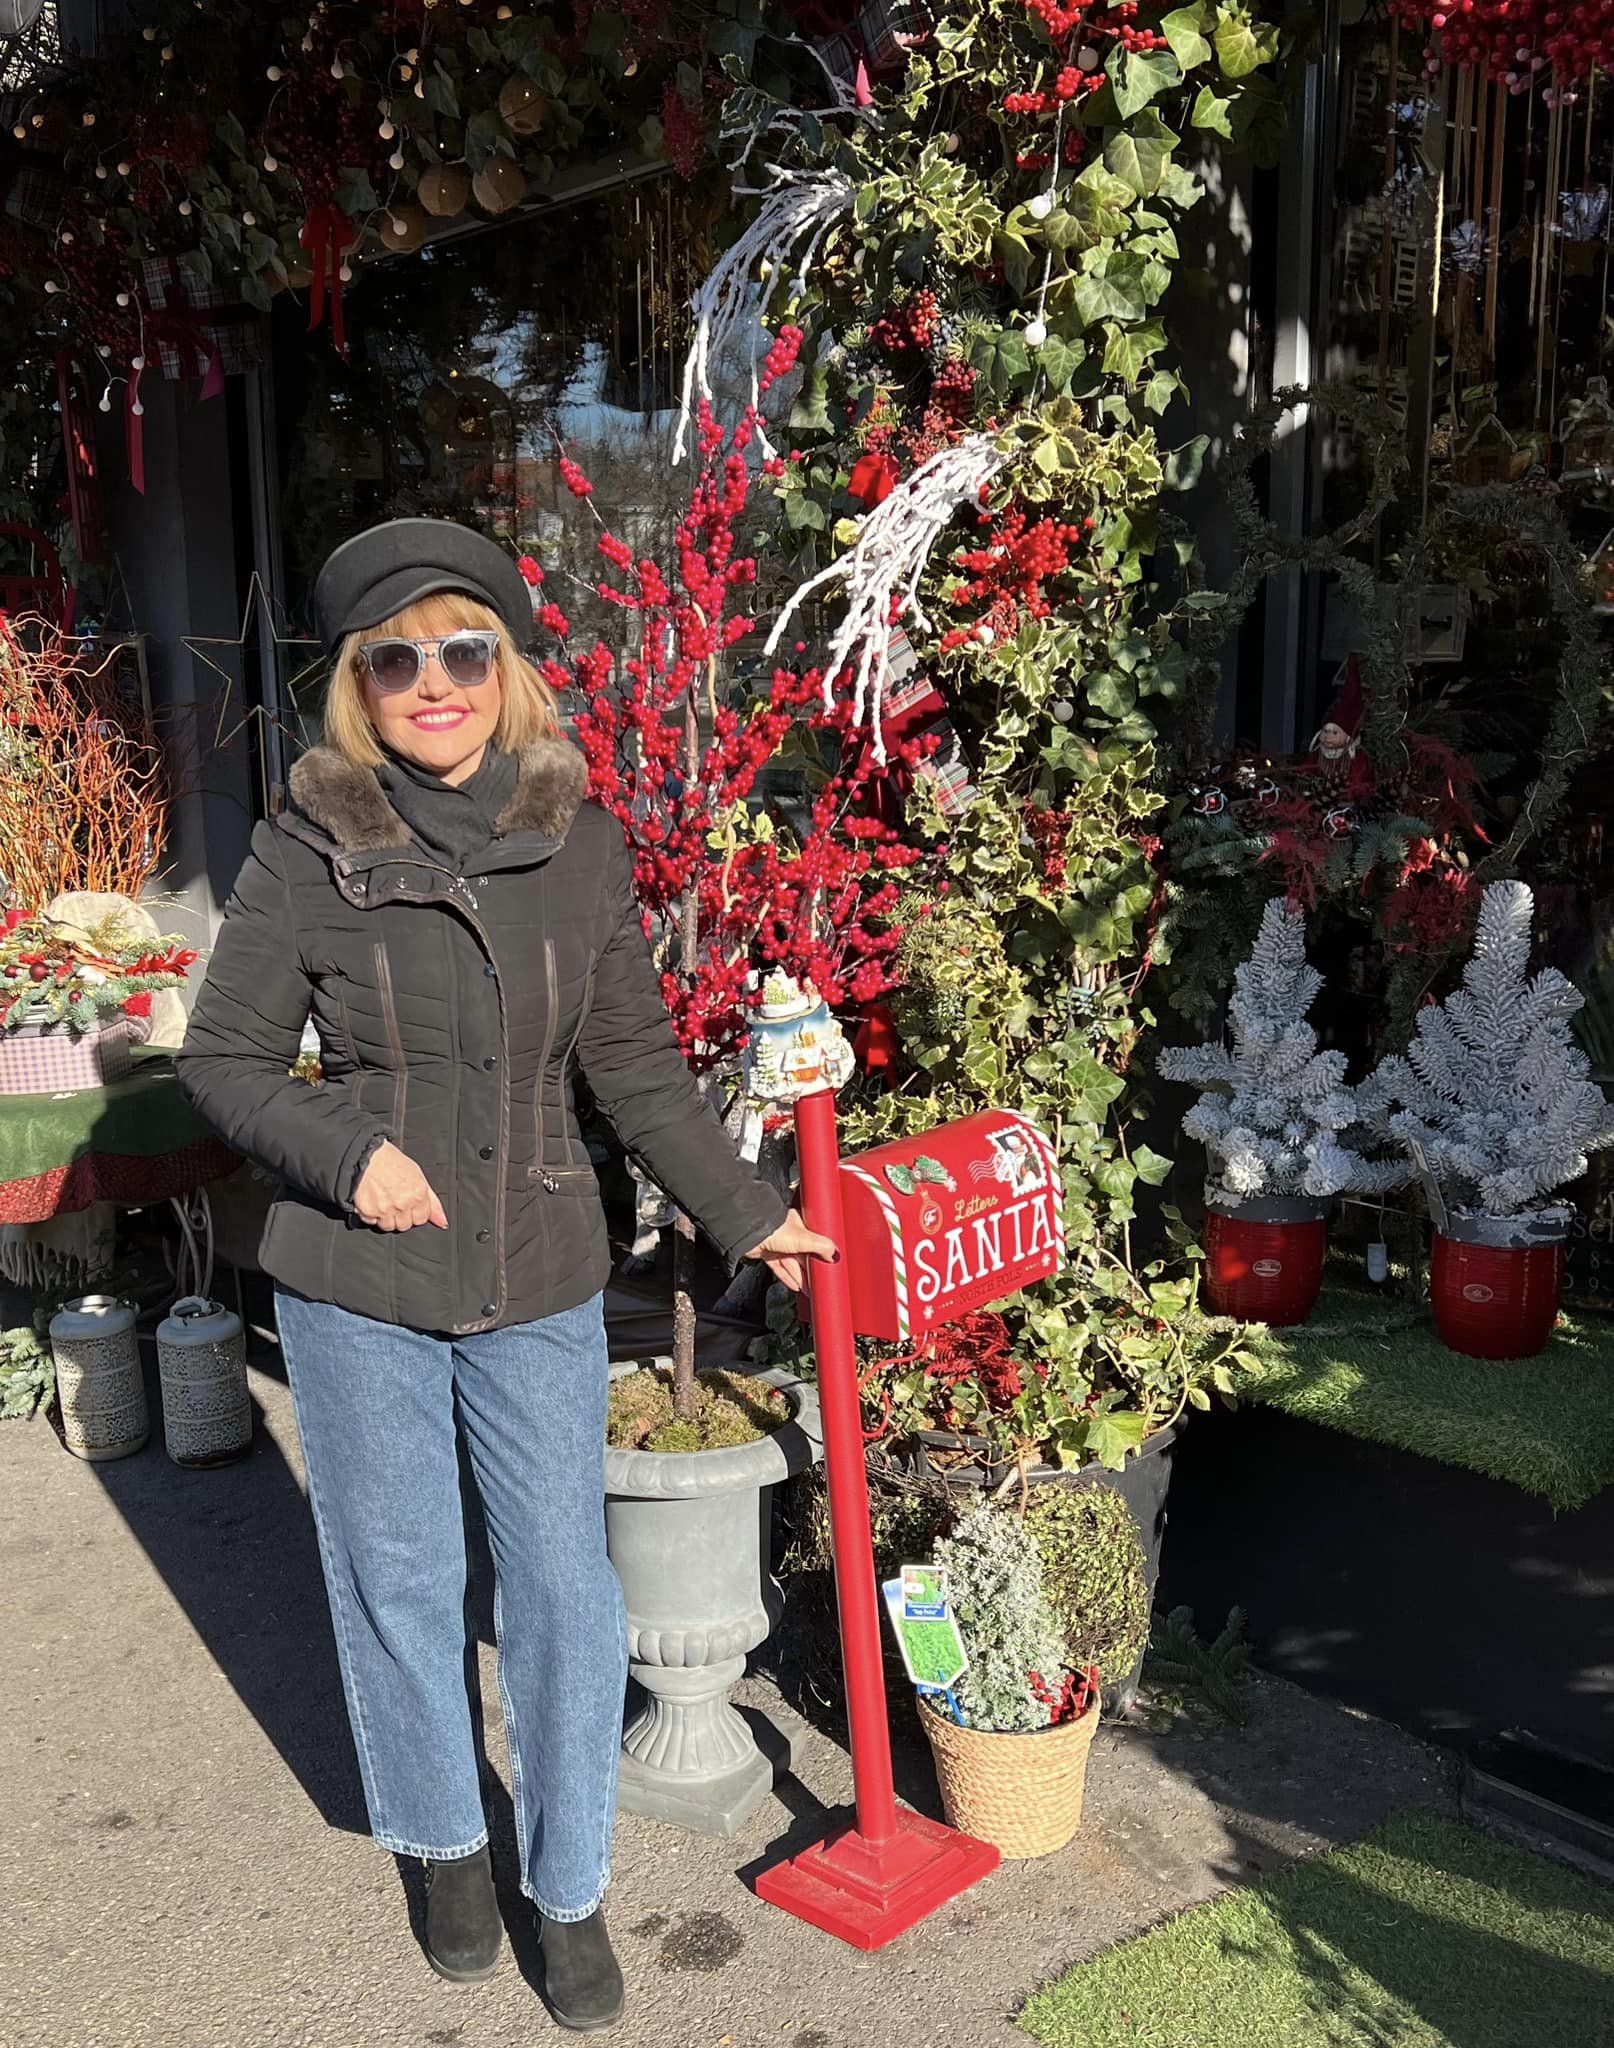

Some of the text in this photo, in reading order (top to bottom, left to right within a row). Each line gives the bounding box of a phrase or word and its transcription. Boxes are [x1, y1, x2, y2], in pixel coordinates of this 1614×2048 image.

[954, 1194, 998, 1222] Letters
[913, 1193, 1056, 1302] SANTA
[958, 1267, 1022, 1306] NORTH POLE
